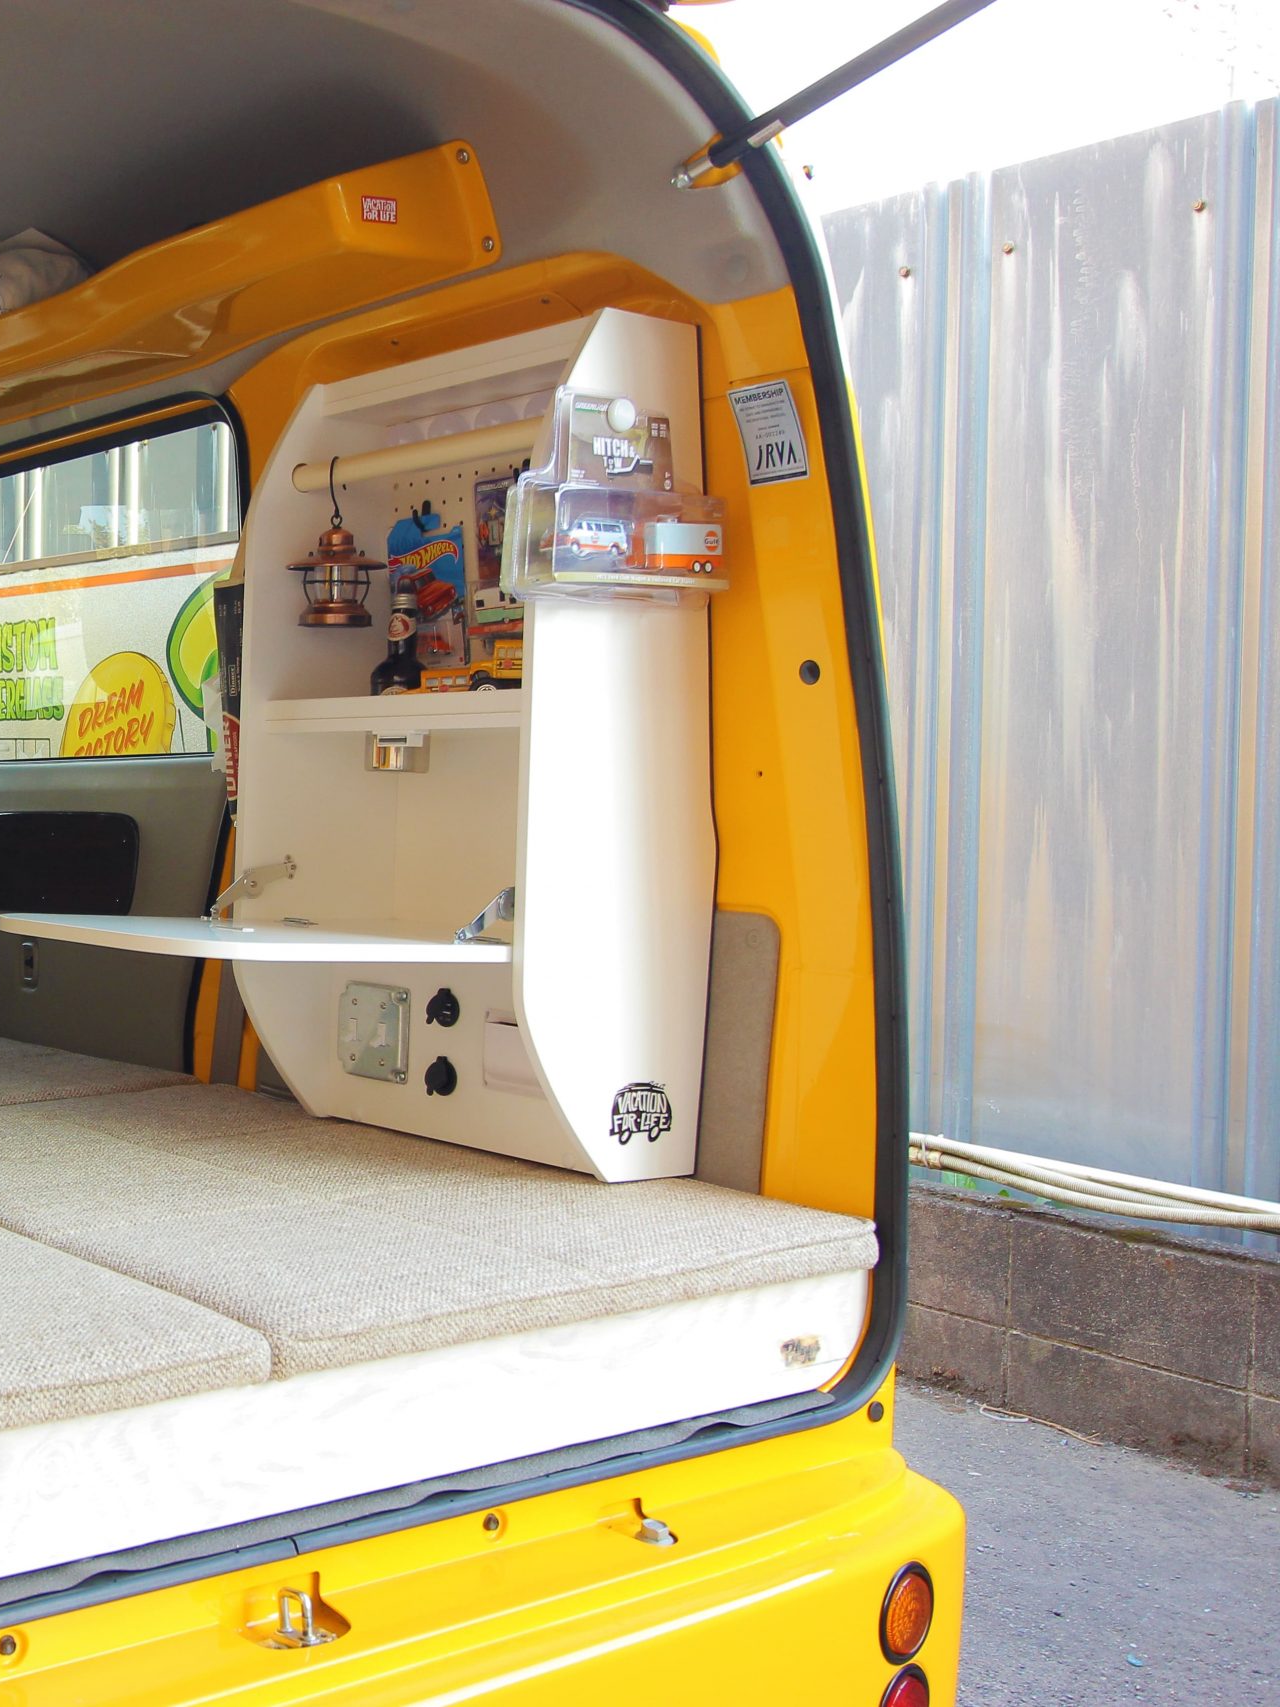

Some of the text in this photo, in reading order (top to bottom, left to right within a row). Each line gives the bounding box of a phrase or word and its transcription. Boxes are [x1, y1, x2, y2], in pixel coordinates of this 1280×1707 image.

[734, 388, 784, 405] MEMBERSHIP
[593, 436, 628, 457] HITCH
[756, 440, 797, 470] JRVA
[704, 536, 719, 545] Gulf
[77, 679, 145, 739] DREAM
[617, 1091, 667, 1113] VACATION
[613, 1112, 668, 1133] FOR LIFE
